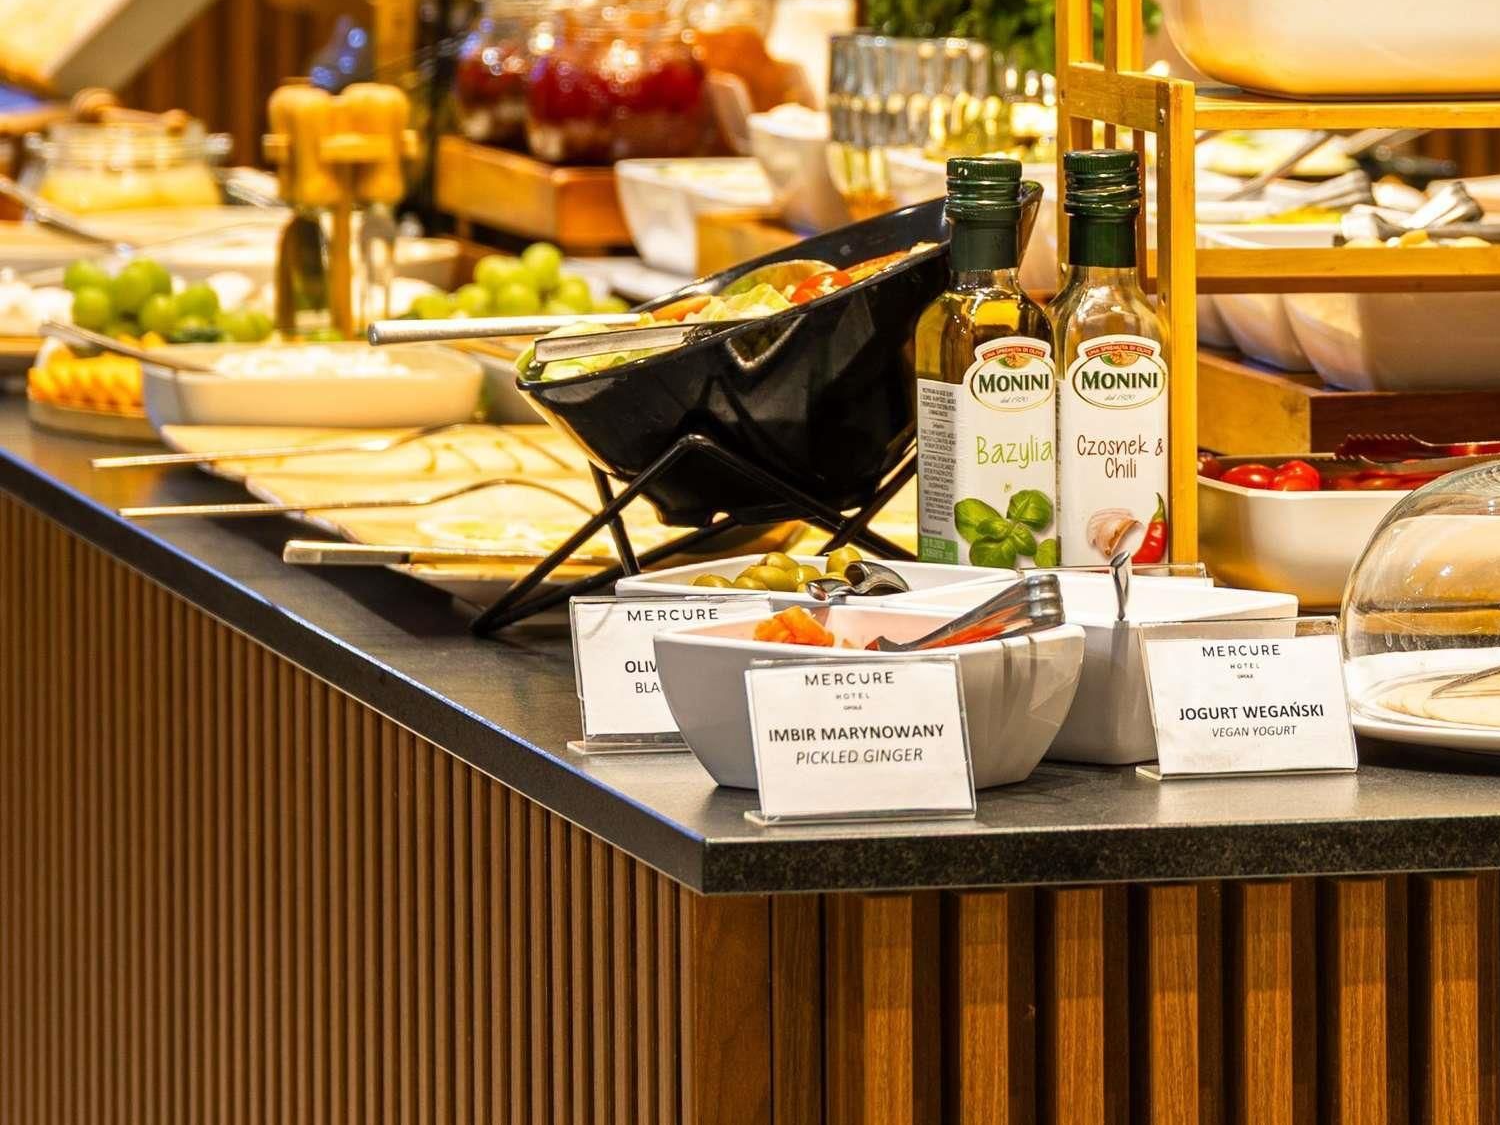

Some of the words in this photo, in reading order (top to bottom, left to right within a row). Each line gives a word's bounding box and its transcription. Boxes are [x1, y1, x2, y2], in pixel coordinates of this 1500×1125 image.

[979, 374, 1049, 393] MONINI
[1082, 371, 1157, 390] MONINI
[976, 435, 1053, 469] Bazylia
[1077, 434, 1149, 456] Czosnek
[1154, 438, 1164, 456] &
[1105, 457, 1137, 478] Chili
[627, 608, 719, 621] MERCURE
[1202, 644, 1281, 657] MERCURE
[624, 660, 657, 673] OLI
[635, 682, 661, 693] BLA
[804, 671, 895, 686] MERCURE
[1179, 707, 1238, 721] JOGURT
[1243, 702, 1324, 718] WEGAŃSKI
[769, 727, 817, 742] IMBIR
[821, 723, 944, 740] MARYNOWANY
[1212, 727, 1249, 737] VEGAN
[1252, 725, 1297, 736] YOGURT
[796, 750, 859, 765] PICKLED
[863, 747, 923, 763] GINGER
